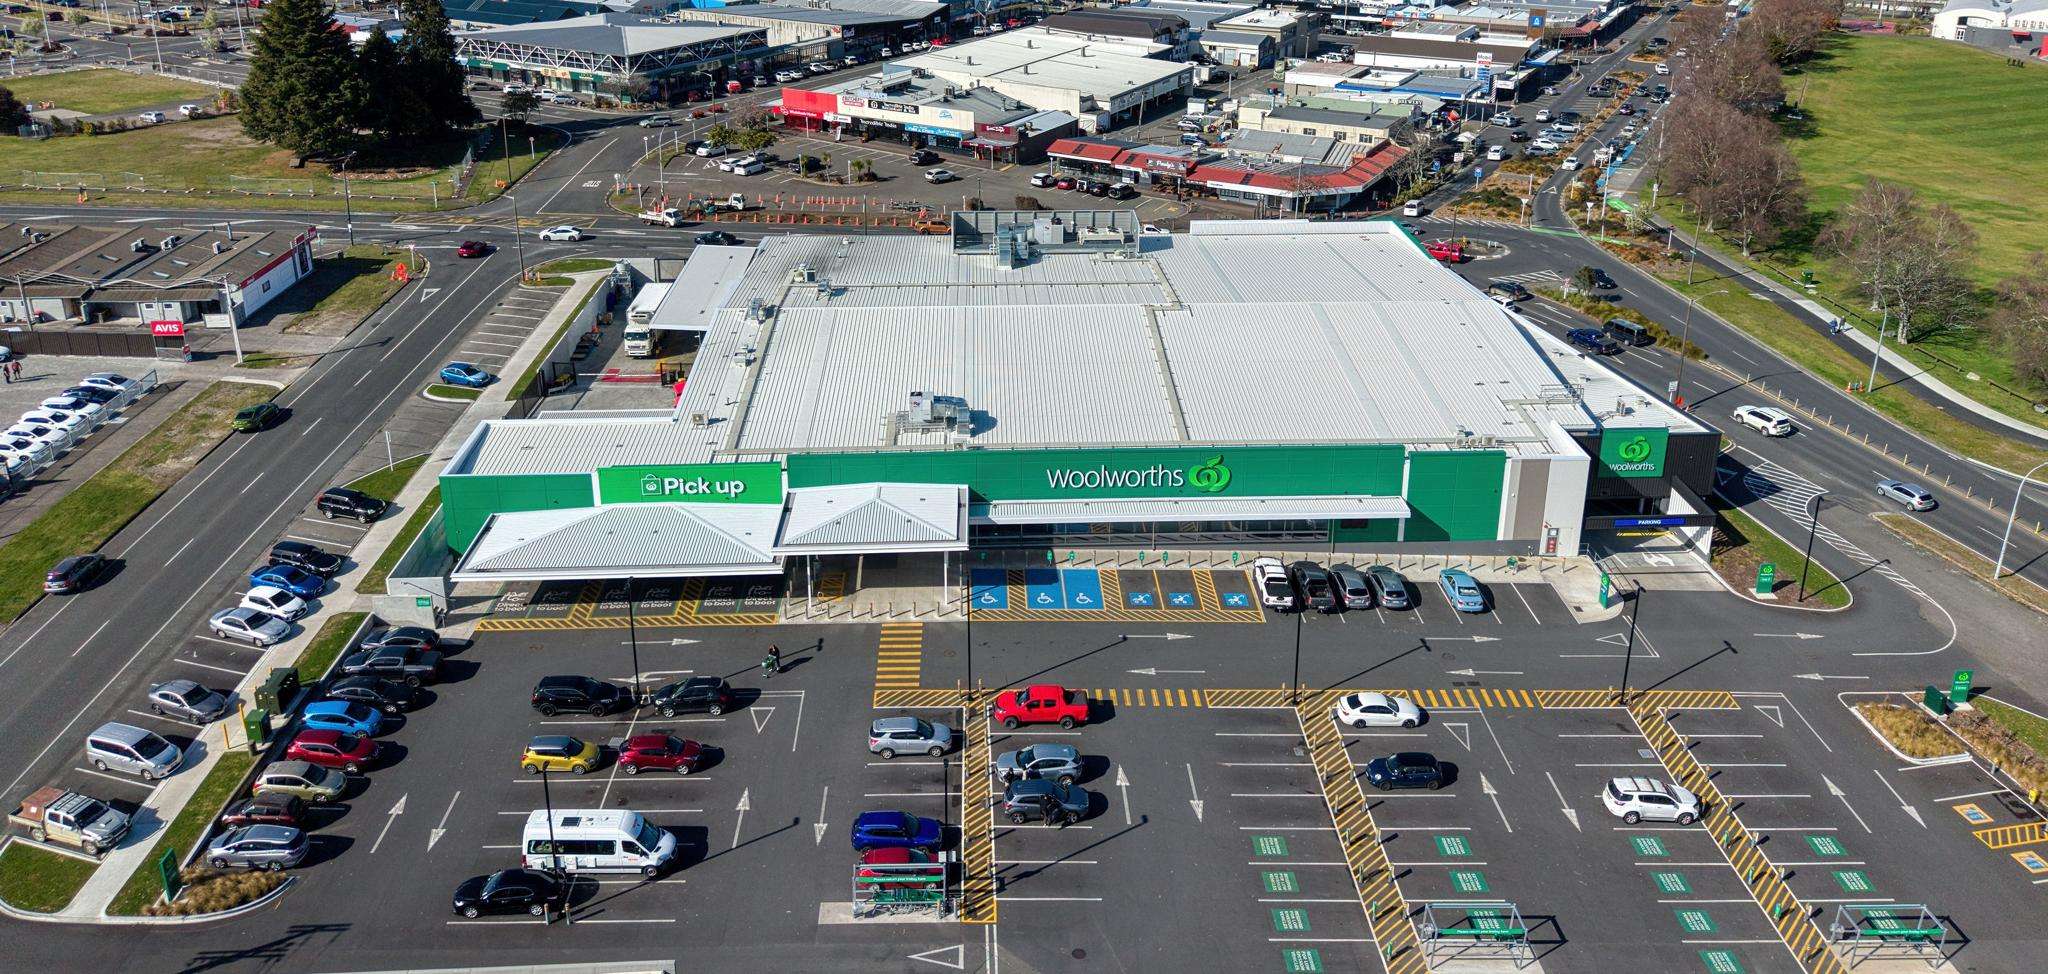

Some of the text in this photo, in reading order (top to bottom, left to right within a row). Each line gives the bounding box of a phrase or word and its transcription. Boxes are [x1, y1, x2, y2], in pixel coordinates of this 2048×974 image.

[154, 324, 178, 332] AVIS
[664, 476, 744, 498] Pick up
[1046, 464, 1184, 488] Woolworths
